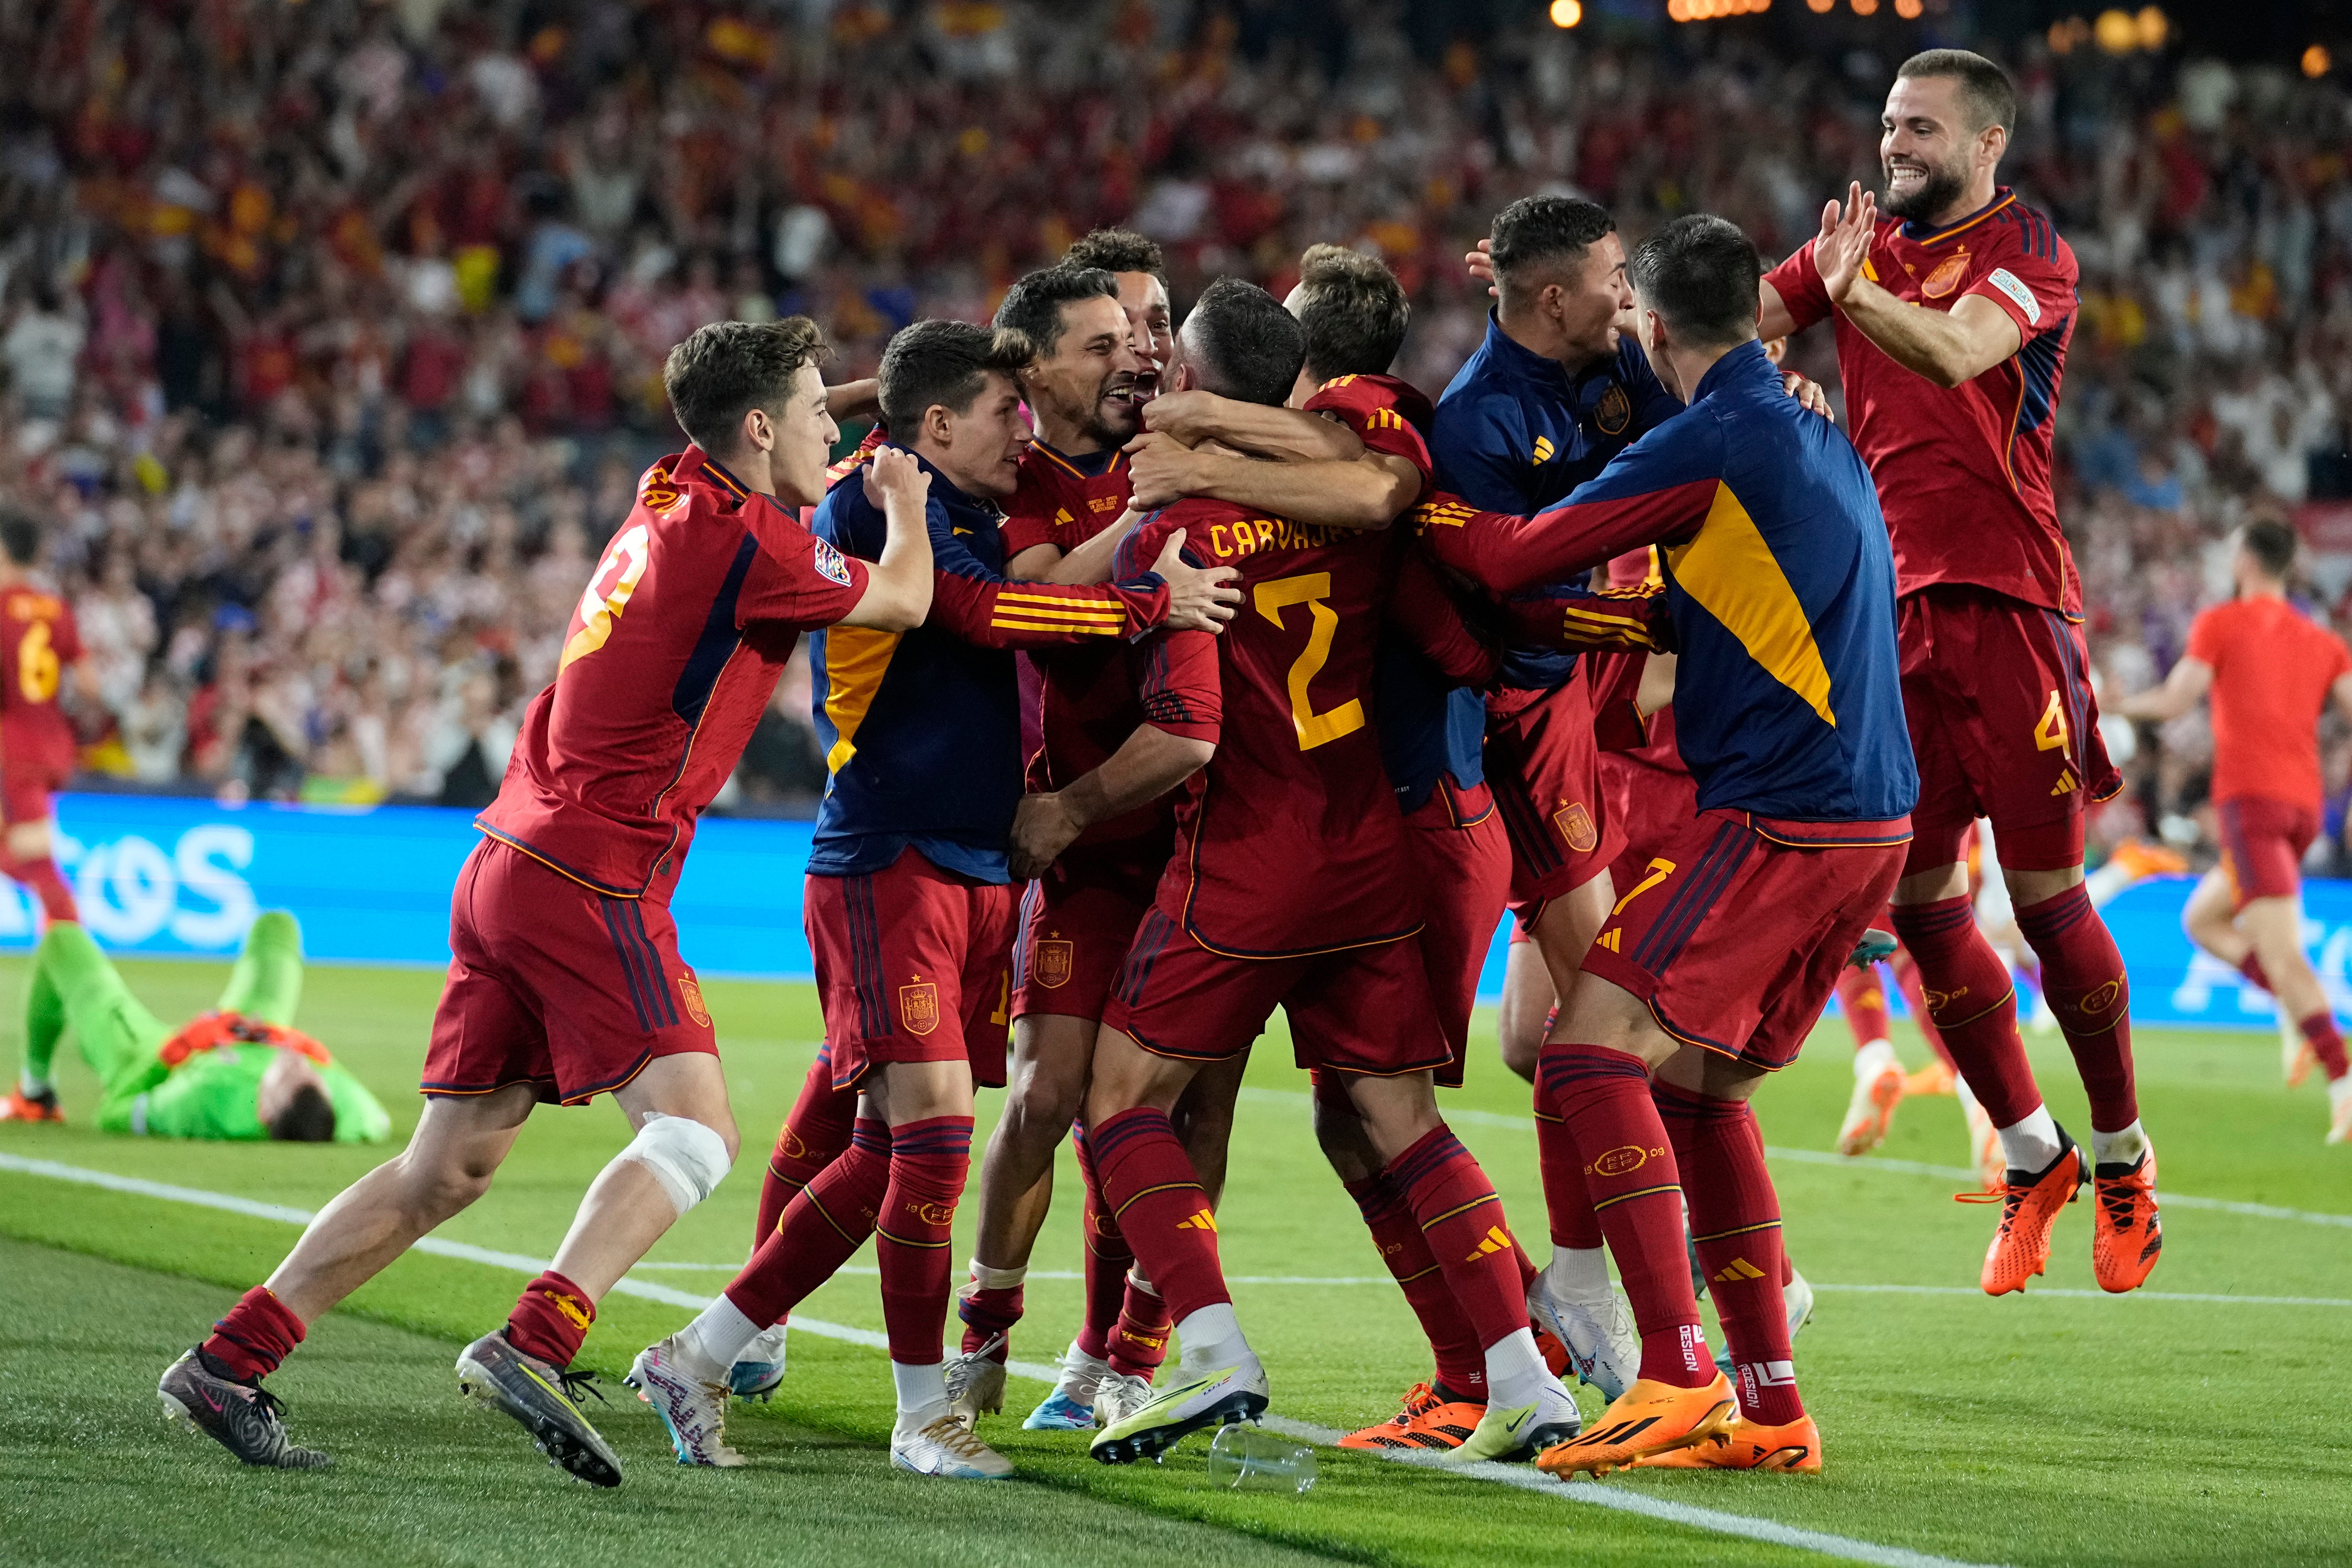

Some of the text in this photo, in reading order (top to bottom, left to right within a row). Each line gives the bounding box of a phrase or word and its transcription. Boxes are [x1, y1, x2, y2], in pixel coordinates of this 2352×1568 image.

[1993, 272, 2037, 319] FOUNDATION
[1211, 519, 1363, 557] CARVAJA
[18, 620, 60, 704] 6
[1253, 572, 1365, 751] 2
[2034, 690, 2071, 760] 4
[1612, 858, 1676, 915] 7
[1584, 1165, 1592, 1175] 19
[1650, 1146, 1665, 1157] 09
[905, 1203, 918, 1213] 19
[1679, 1325, 1699, 1371] DESIGN
